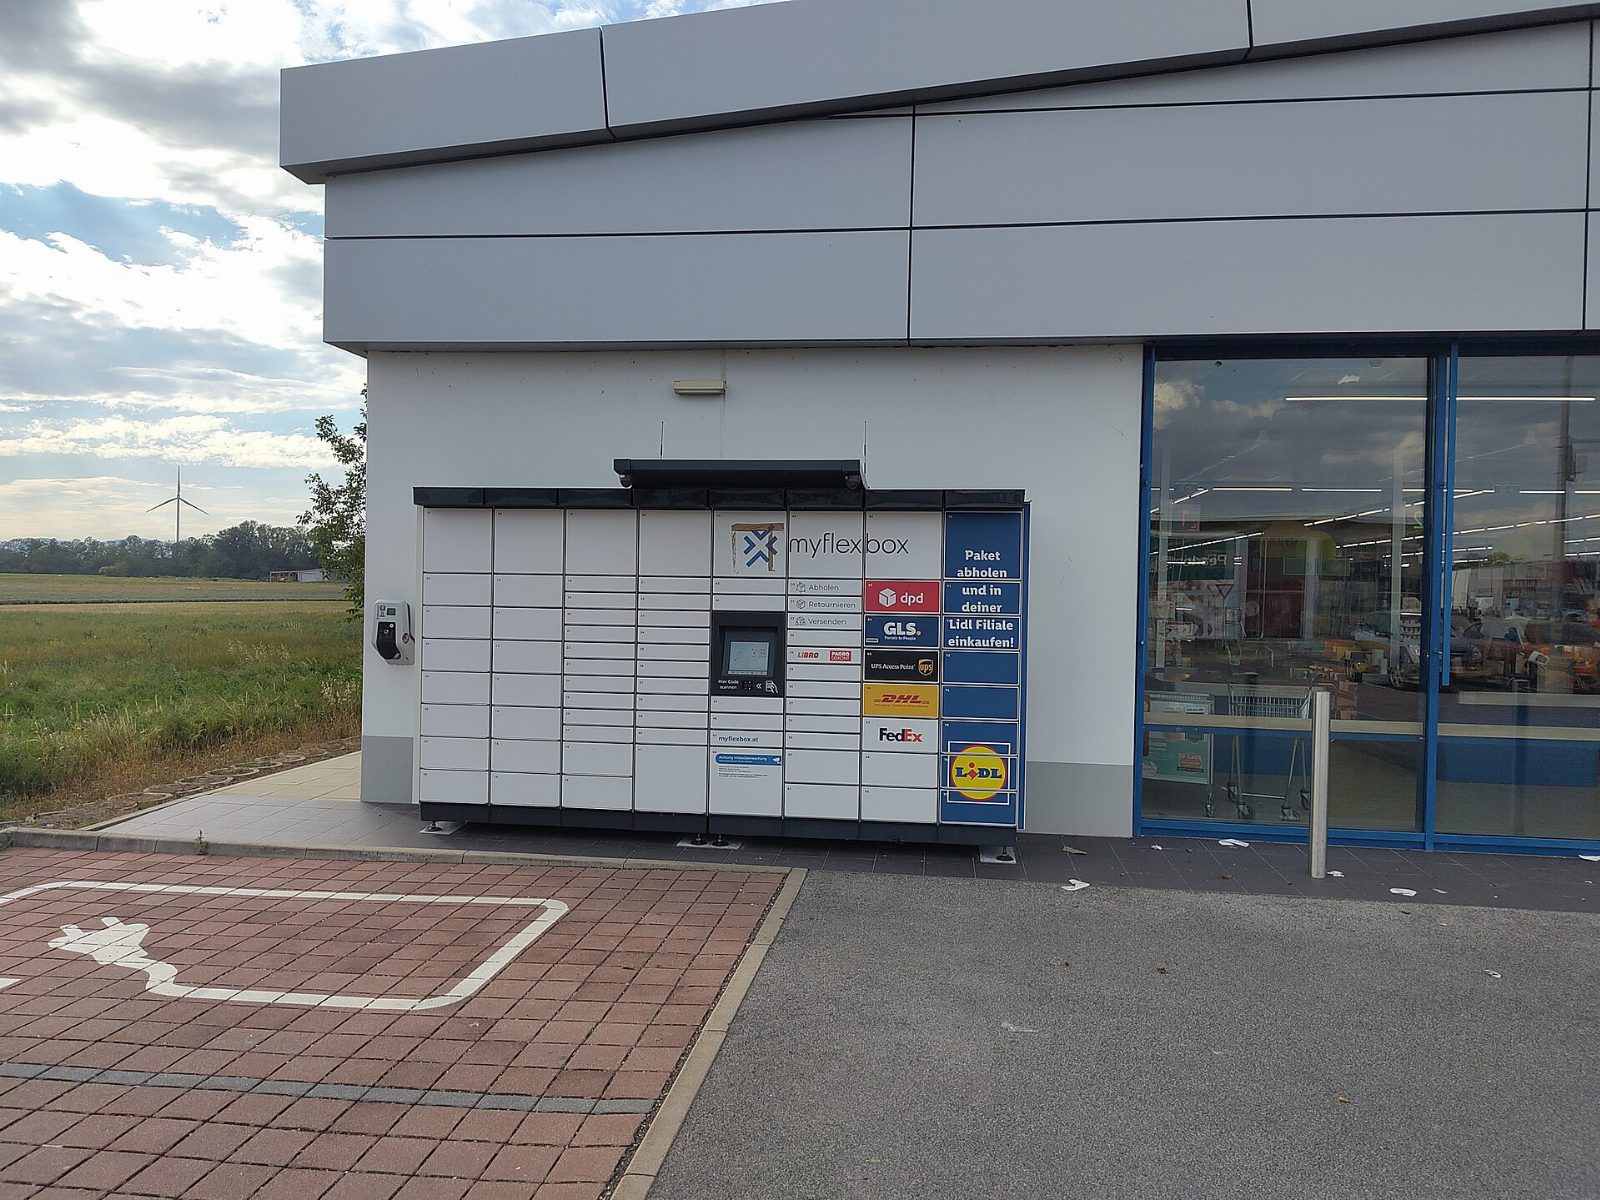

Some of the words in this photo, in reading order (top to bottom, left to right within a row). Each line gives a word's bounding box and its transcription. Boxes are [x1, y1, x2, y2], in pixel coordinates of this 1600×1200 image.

[789, 532, 909, 558] myflexbox
[964, 549, 1001, 561] Paket
[956, 566, 1007, 578] abholen
[962, 584, 987, 595] und
[989, 584, 1002, 596] in
[808, 601, 856, 609] Retournieren
[900, 592, 924, 606] dpd
[961, 601, 1003, 613] deiner
[807, 618, 847, 626] Versenden
[949, 618, 973, 630] Lidl
[976, 619, 1014, 631] Filiale
[948, 635, 1014, 648] einkaufen!
[797, 651, 820, 659] LIBRO
[919, 664, 932, 673] ups
[881, 694, 922, 704] DHL
[718, 735, 759, 743] myflexbox.at
[879, 728, 923, 742] FedEx
[955, 761, 1003, 780] LIDL
